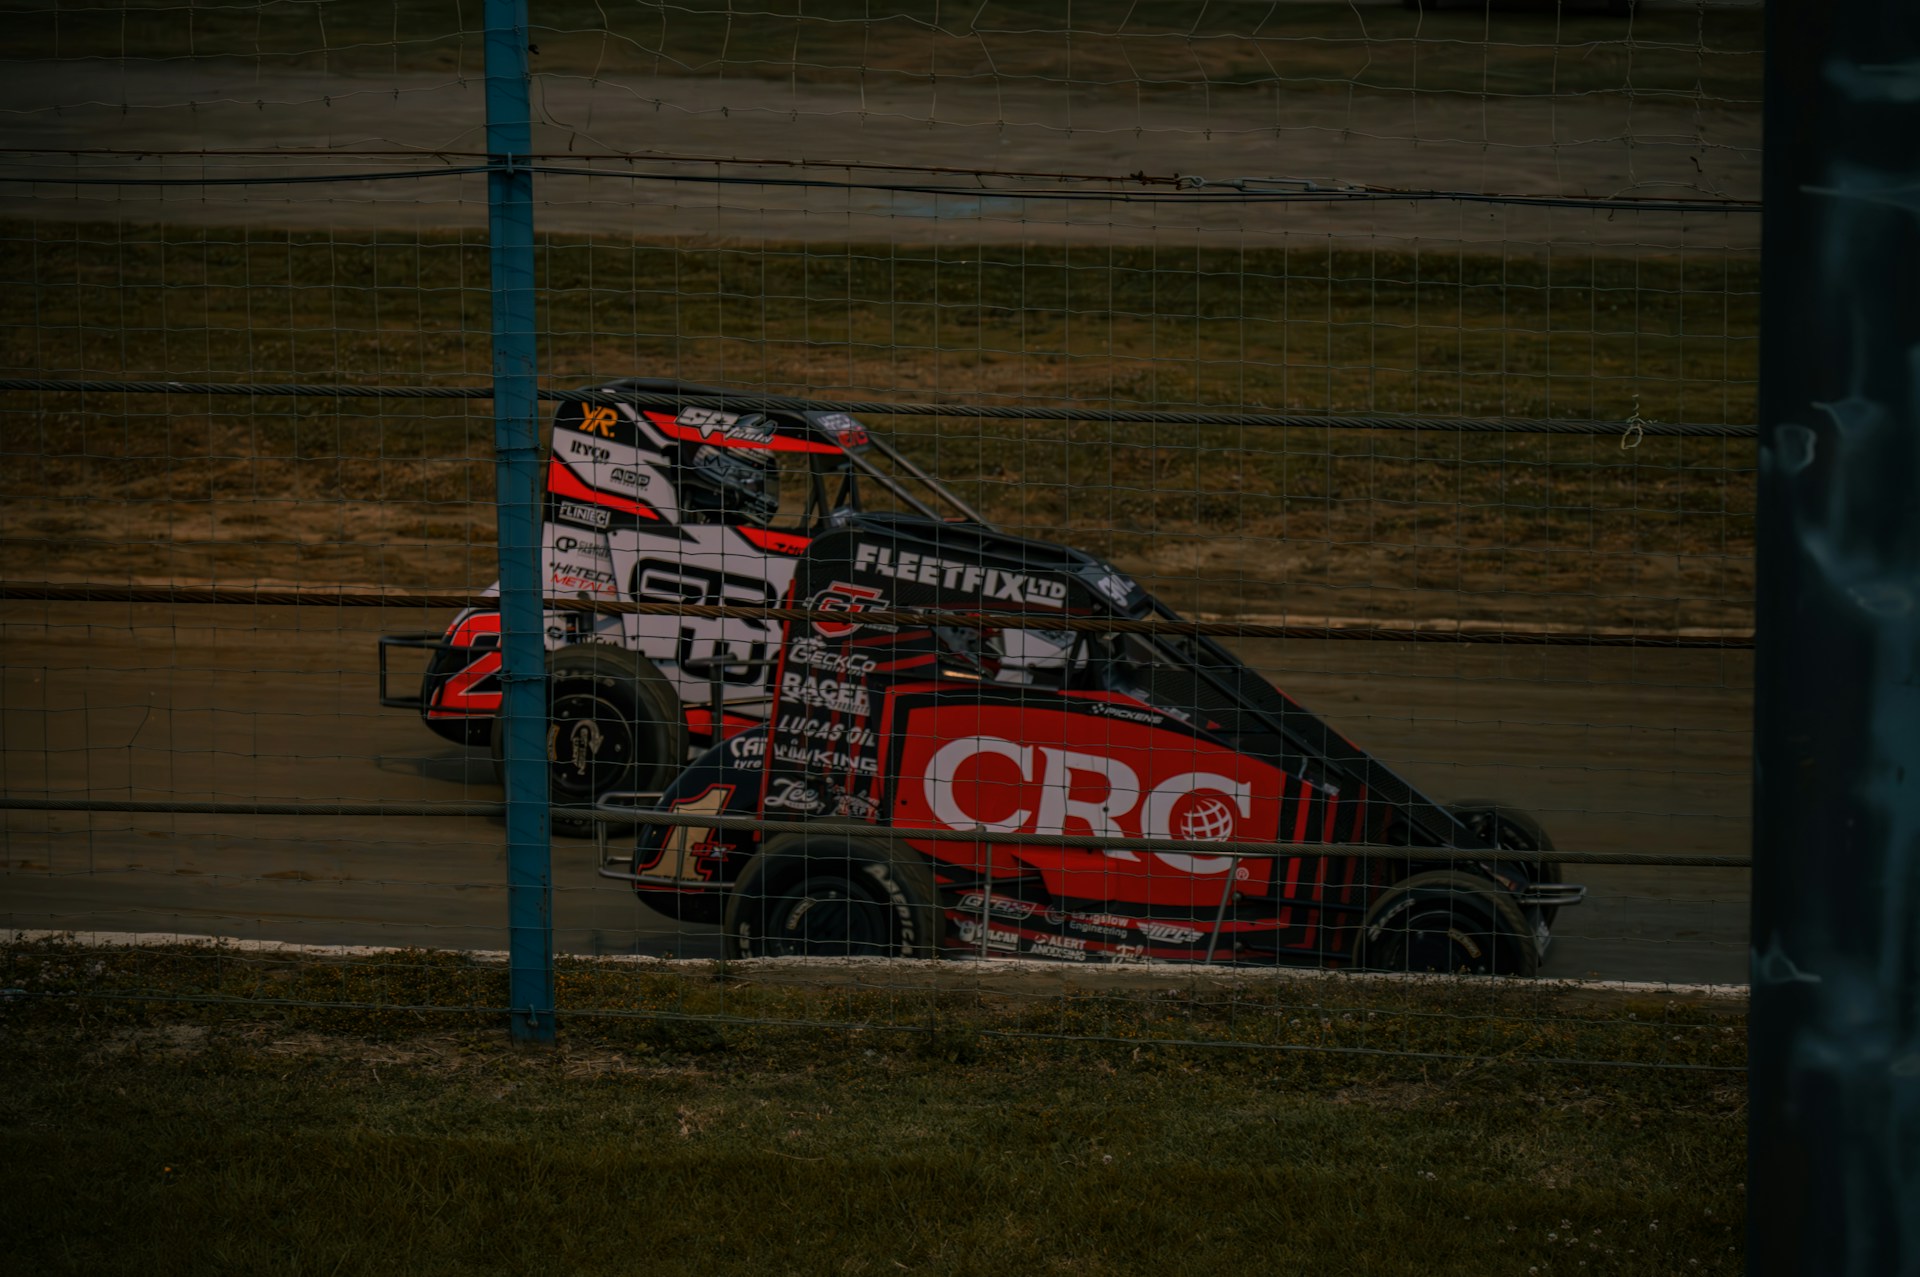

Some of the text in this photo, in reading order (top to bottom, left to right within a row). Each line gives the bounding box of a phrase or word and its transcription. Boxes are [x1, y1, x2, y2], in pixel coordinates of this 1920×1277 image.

[571, 441, 610, 459] RYCO
[855, 542, 1025, 604] FLEETFIX
[1024, 577, 1068, 600] LTD
[1104, 708, 1164, 725] PICKENS
[777, 714, 877, 748] LUCAS OIL
[923, 735, 1252, 874] CRC
[1069, 920, 1128, 940] Engineering
[1048, 936, 1087, 951] ALERT
